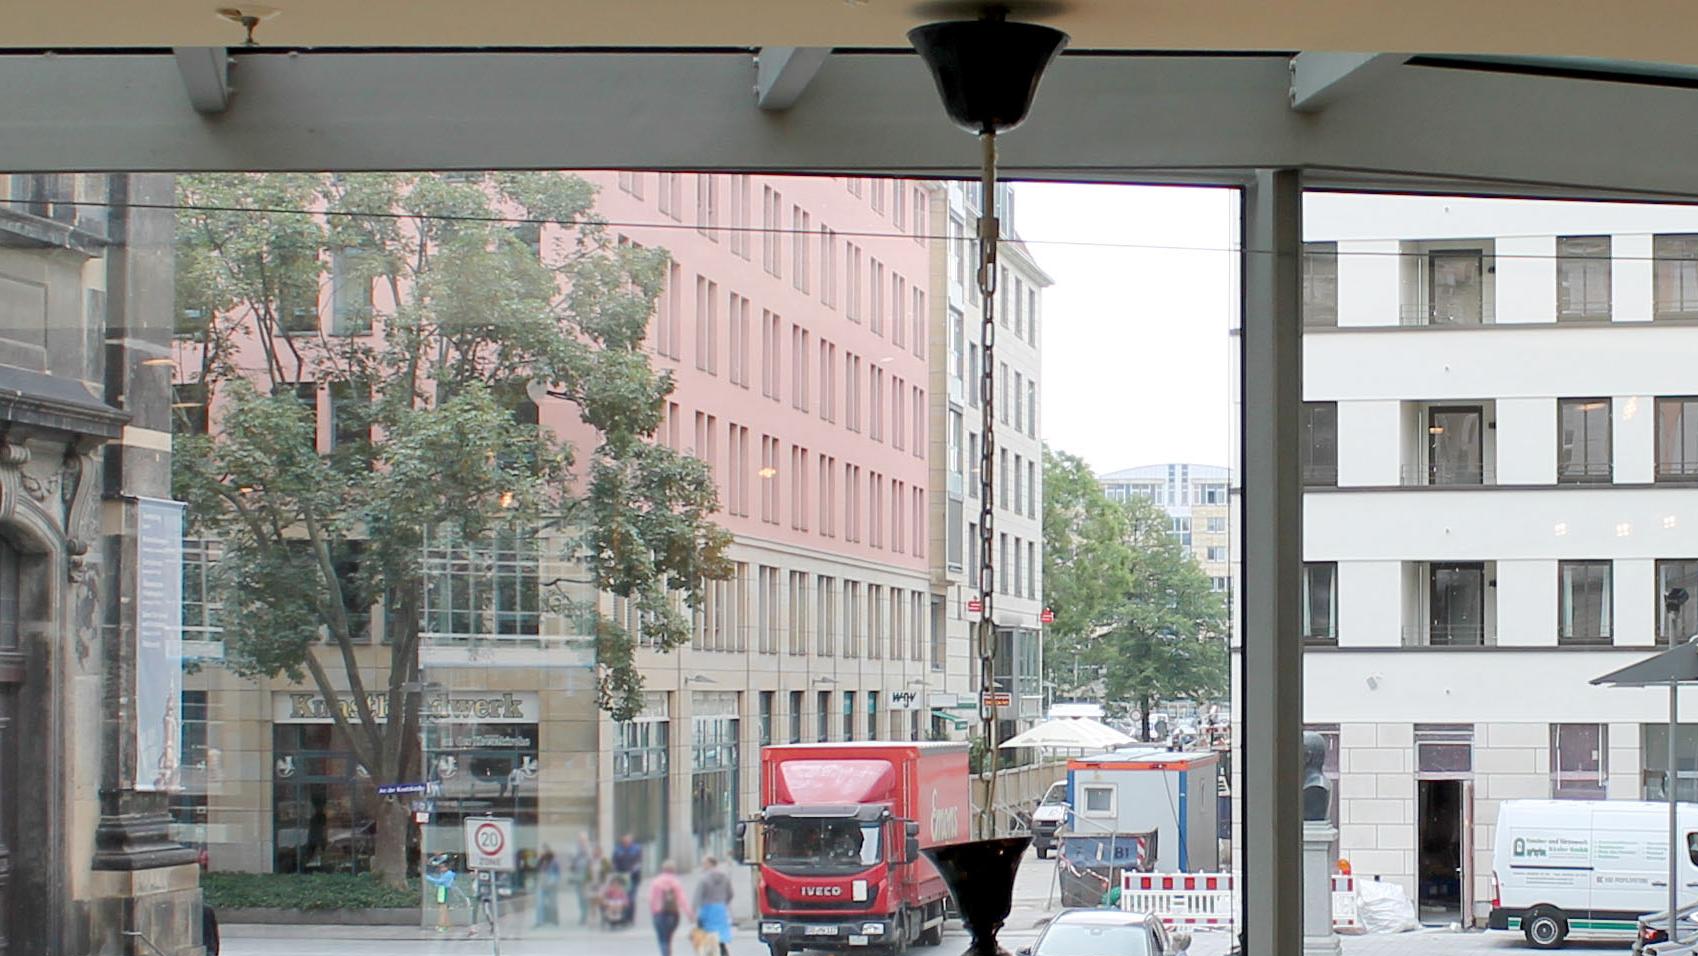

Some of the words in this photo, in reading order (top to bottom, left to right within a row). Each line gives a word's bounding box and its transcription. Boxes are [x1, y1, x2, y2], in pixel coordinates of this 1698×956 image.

[288, 692, 524, 719] Kusthdwerk
[480, 831, 498, 847] 20
[801, 886, 841, 896] IVECO
